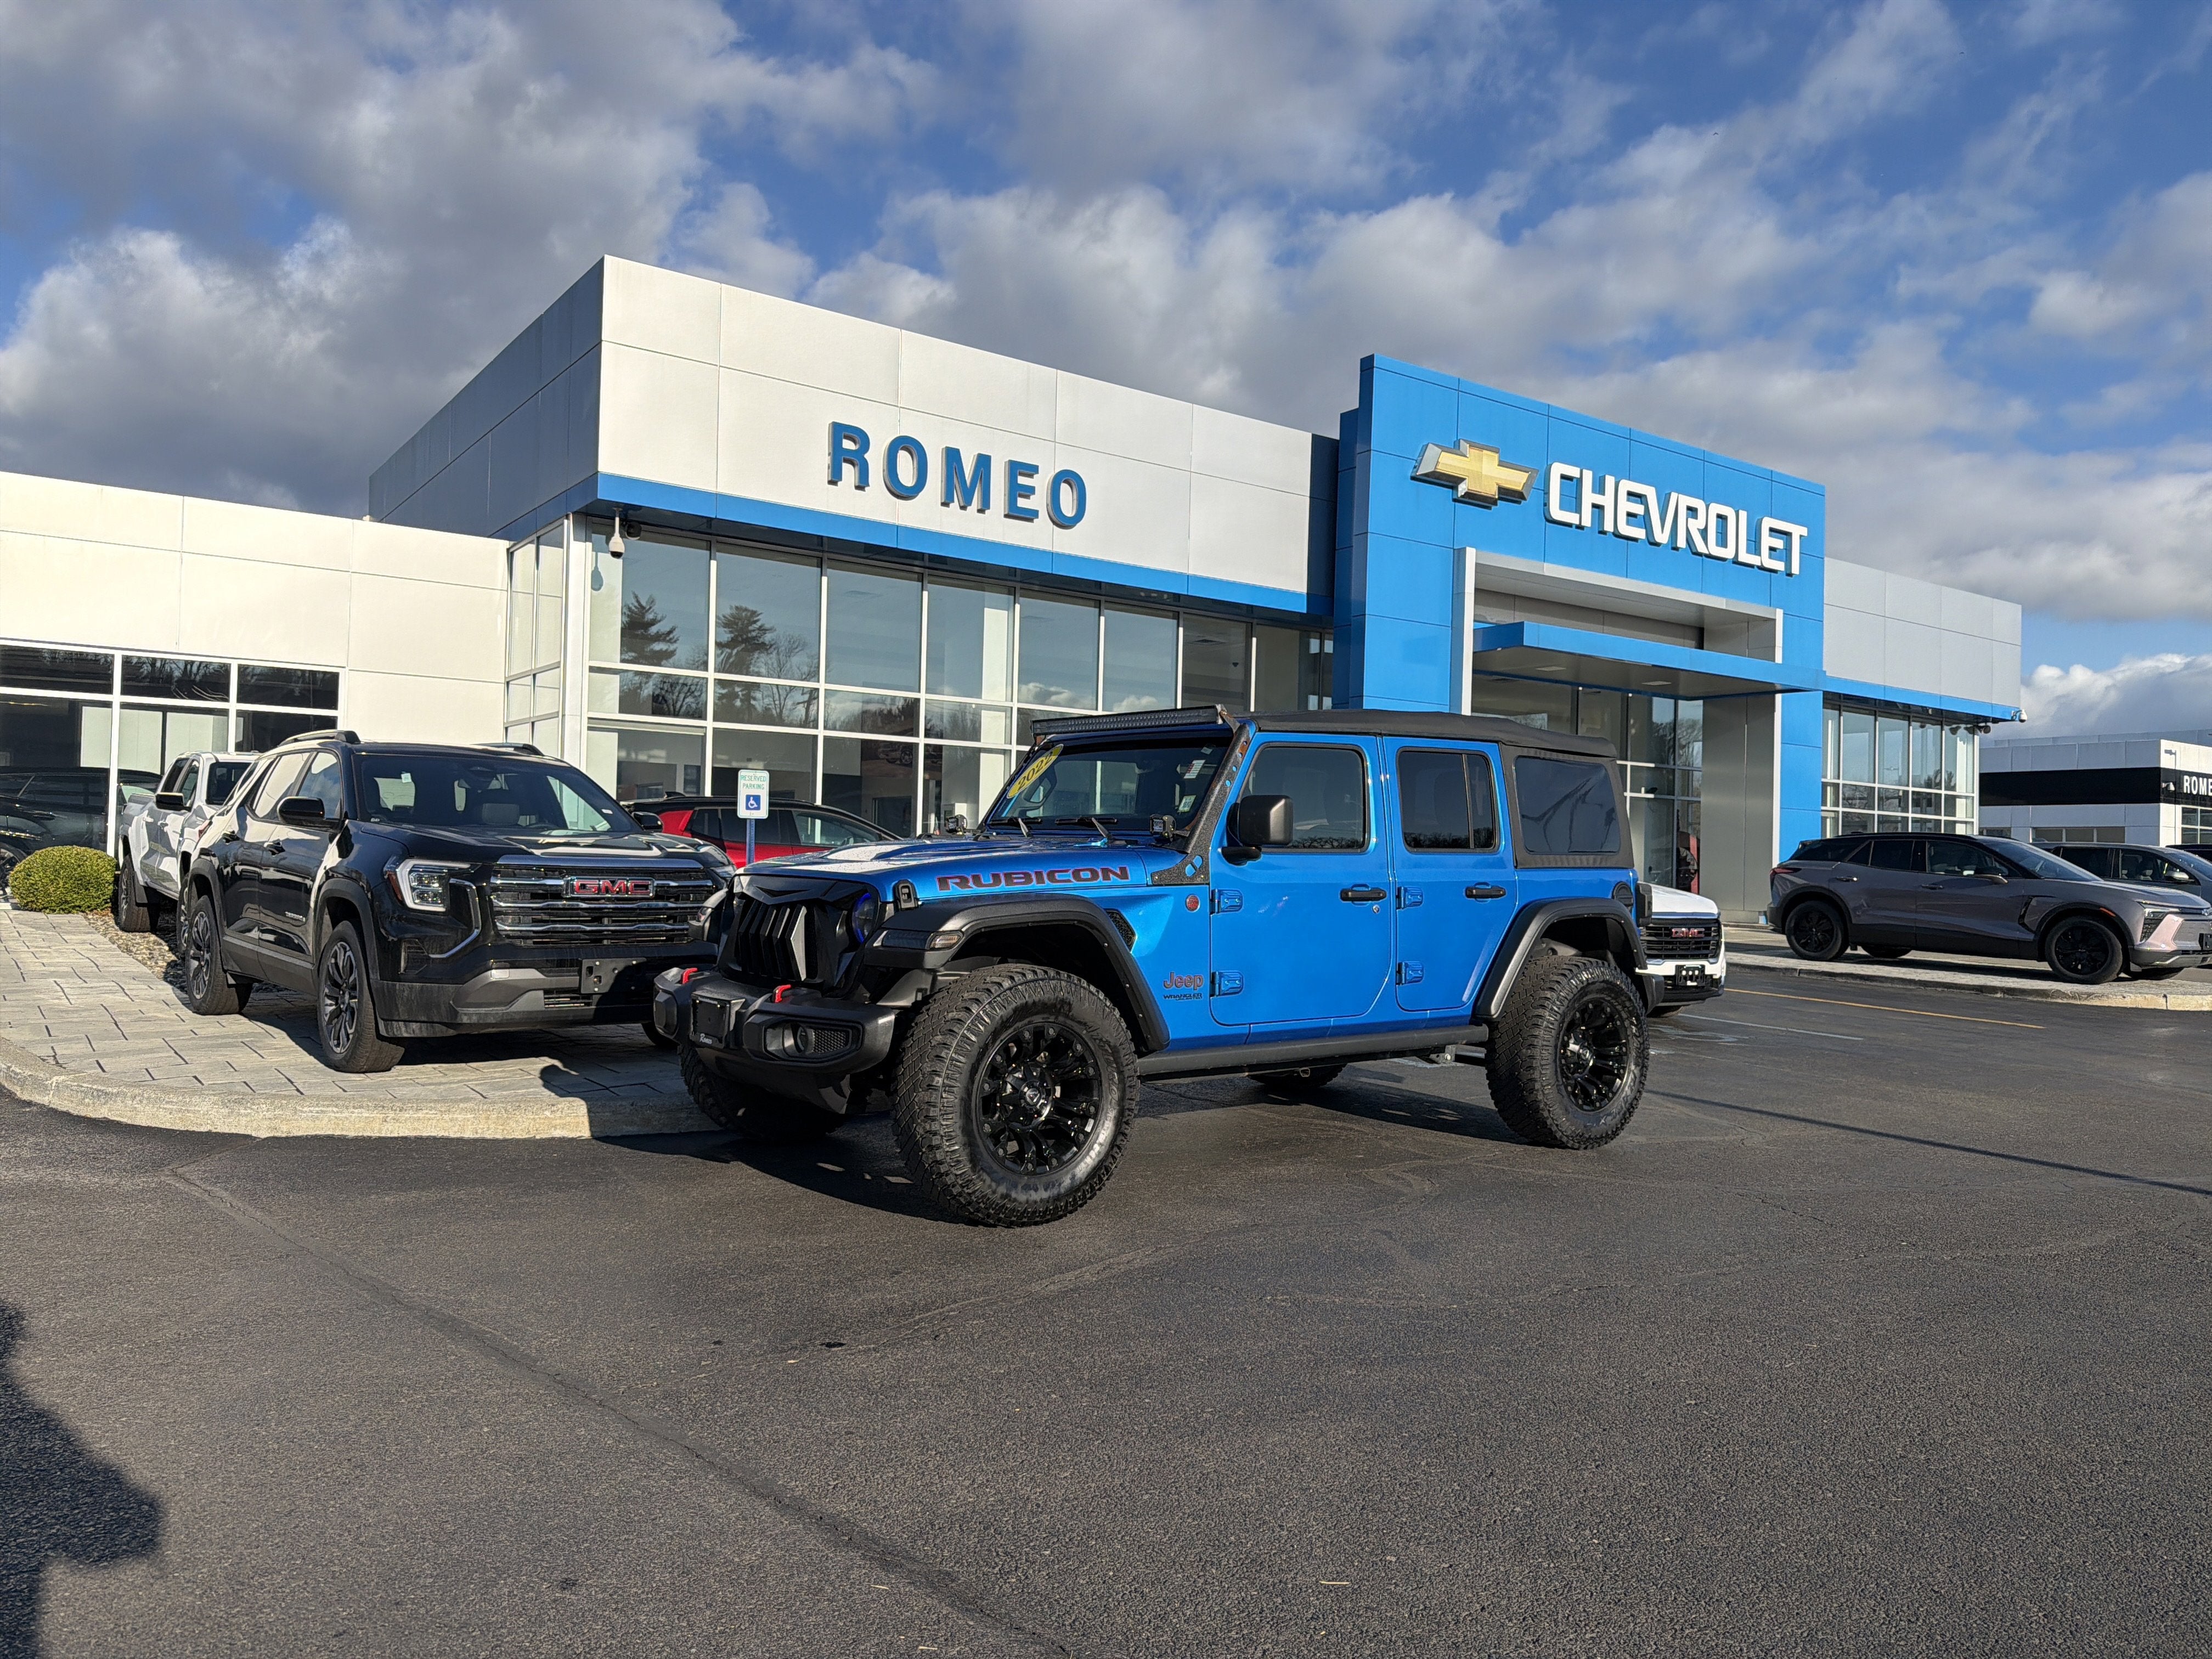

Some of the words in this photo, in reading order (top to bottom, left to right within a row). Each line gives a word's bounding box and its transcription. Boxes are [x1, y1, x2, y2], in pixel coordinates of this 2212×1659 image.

[827, 421, 1086, 528] ROMEO
[1546, 462, 1808, 575] CHEVROLET
[1017, 751, 1053, 792] 2022
[574, 880, 651, 894] GMC
[936, 866, 1130, 891] RUBICON
[1672, 928, 1705, 937] GMC
[1163, 972, 1203, 990] Jeep
